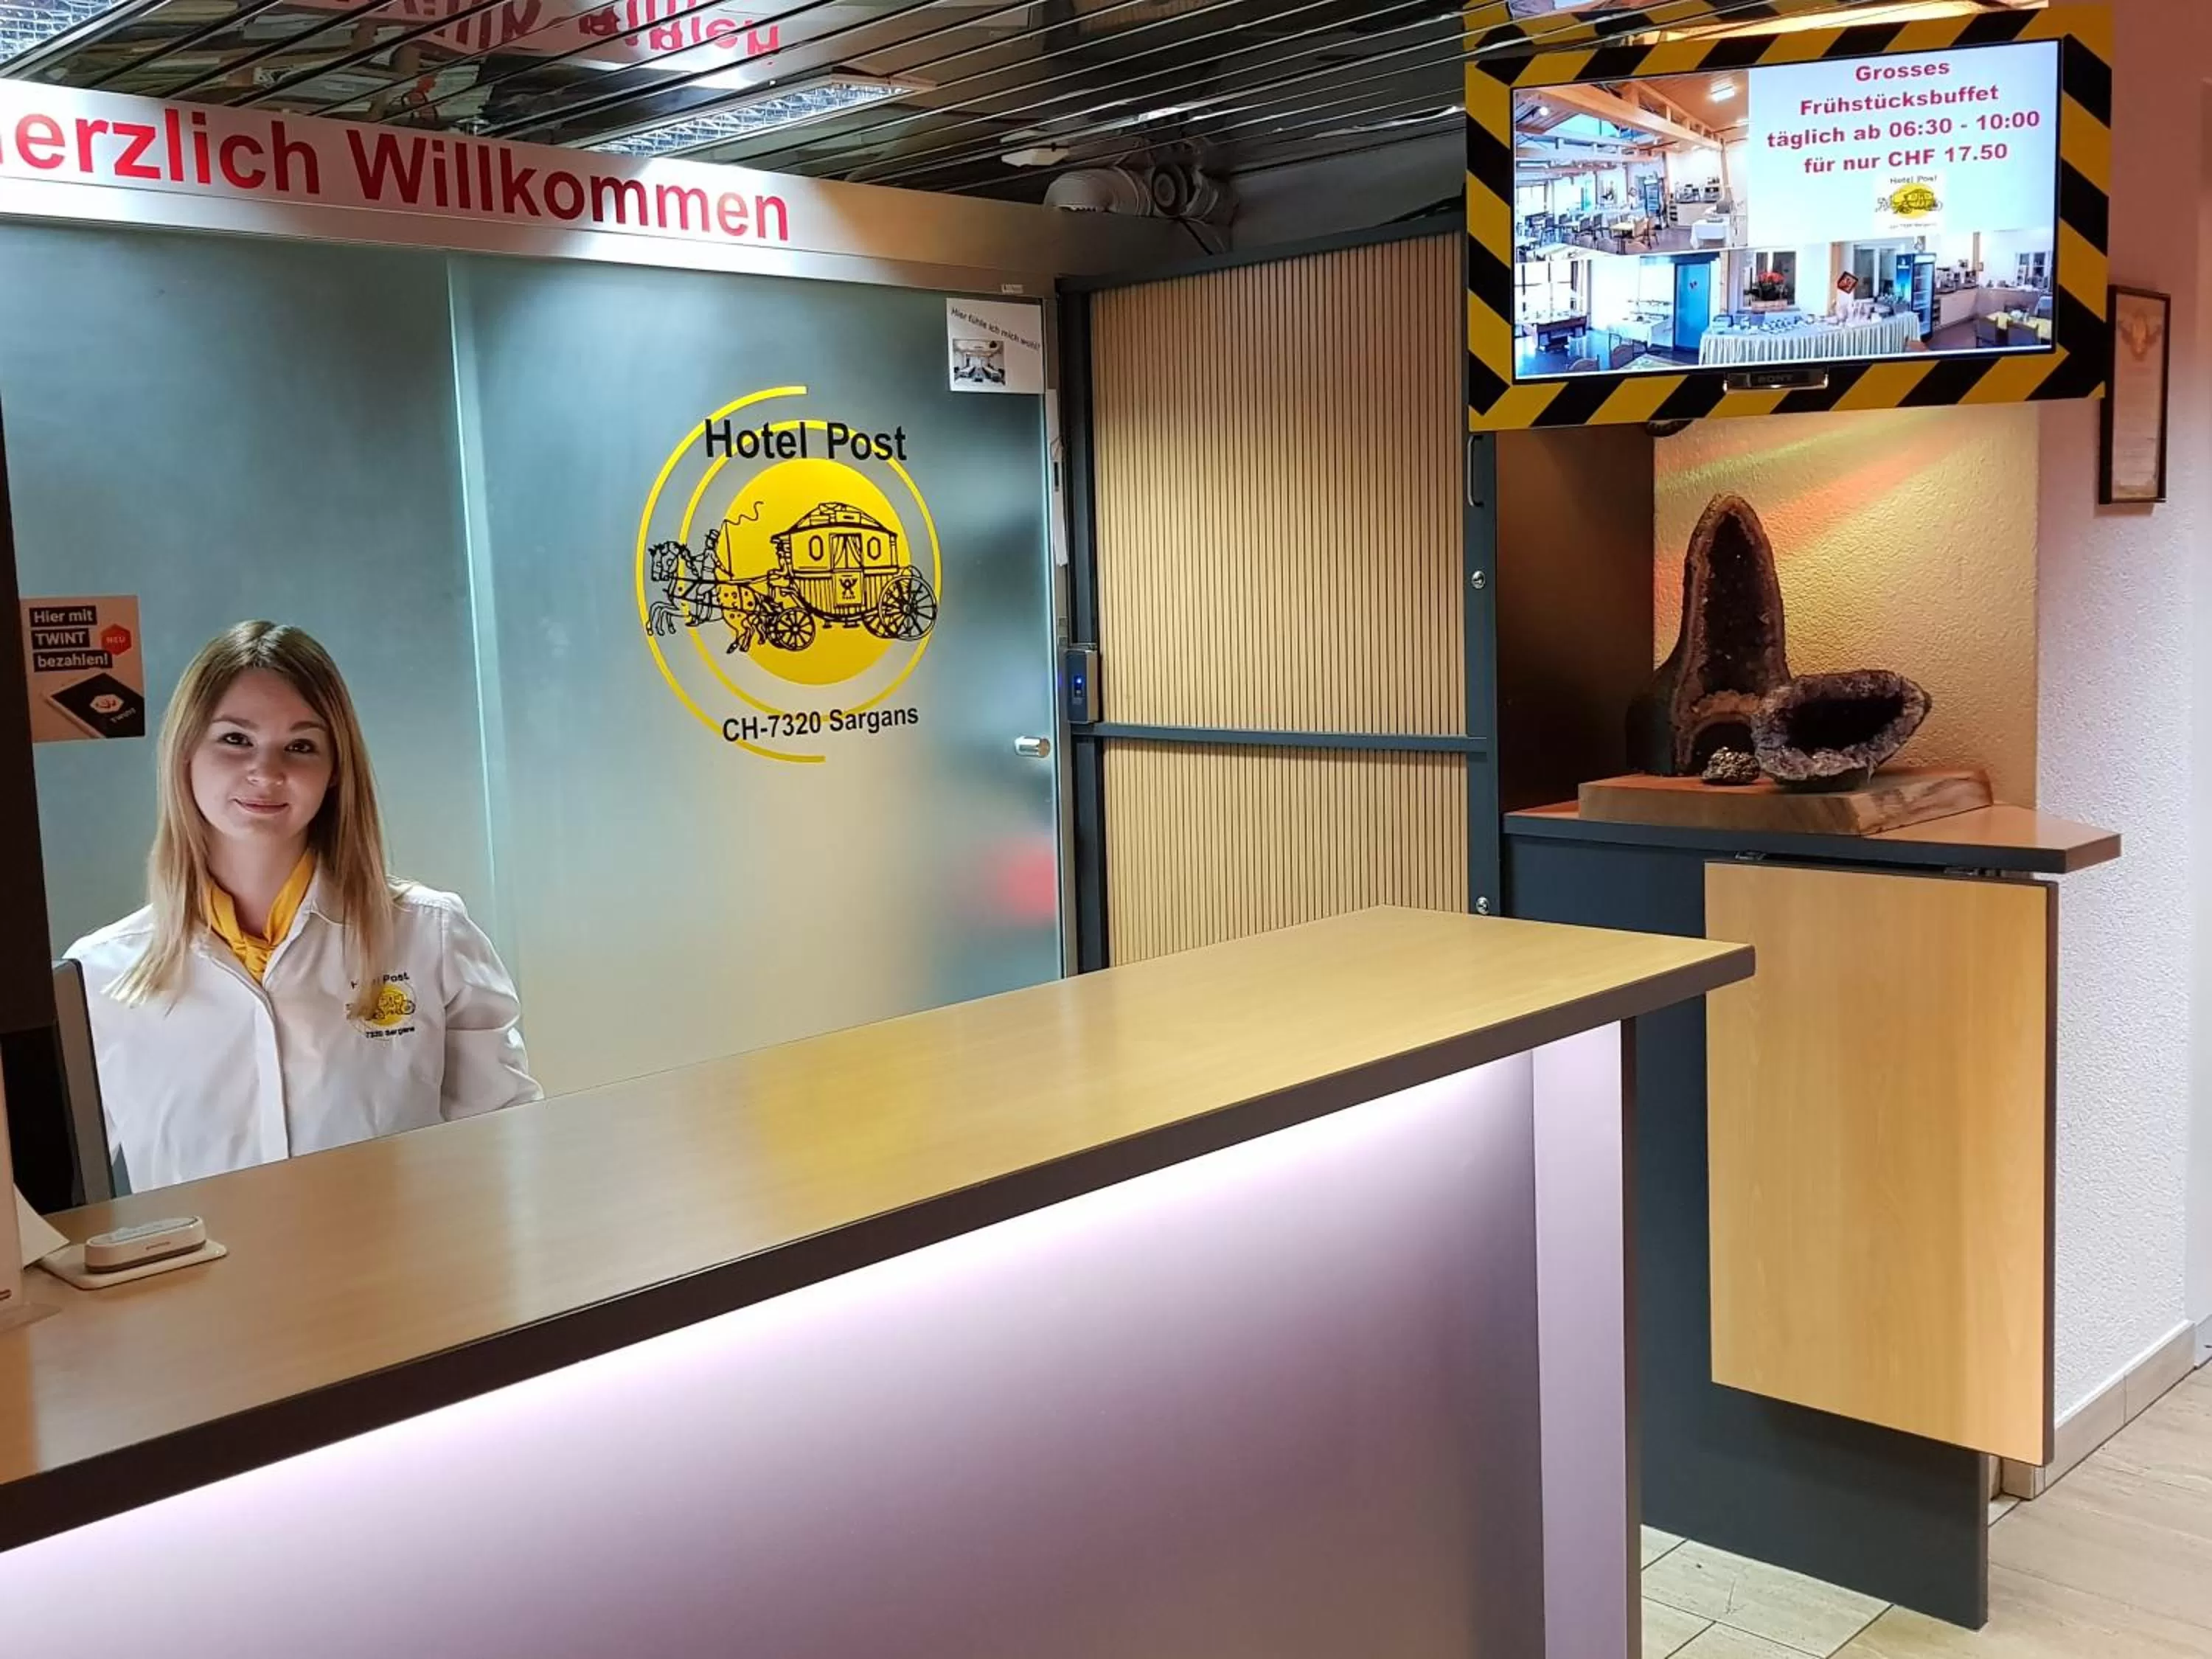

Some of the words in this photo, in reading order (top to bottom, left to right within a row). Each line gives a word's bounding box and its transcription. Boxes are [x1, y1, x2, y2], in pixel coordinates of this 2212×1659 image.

[1855, 62, 1950, 82] Grosses
[1800, 85, 1999, 115] Frühstücksbuffet
[1767, 127, 1845, 150] täglich
[1854, 125, 1881, 141] ab
[1889, 118, 1952, 138] 06:30
[1976, 111, 2040, 131] 10:00
[1804, 158, 1835, 173] für
[1843, 156, 1880, 171] nur
[1888, 149, 1935, 167] CHF
[1944, 144, 2008, 162] 17.50
[0, 108, 320, 194] erzlich
[346, 129, 790, 241] Willkommen
[705, 419, 807, 459] Hotel
[826, 422, 908, 461] Post
[34, 610, 65, 623] Hier
[69, 608, 93, 622] mit
[35, 631, 86, 646] TWINT
[38, 653, 108, 668] bezahlen!
[723, 712, 821, 742] CH-7320
[830, 707, 919, 735] Sargans
